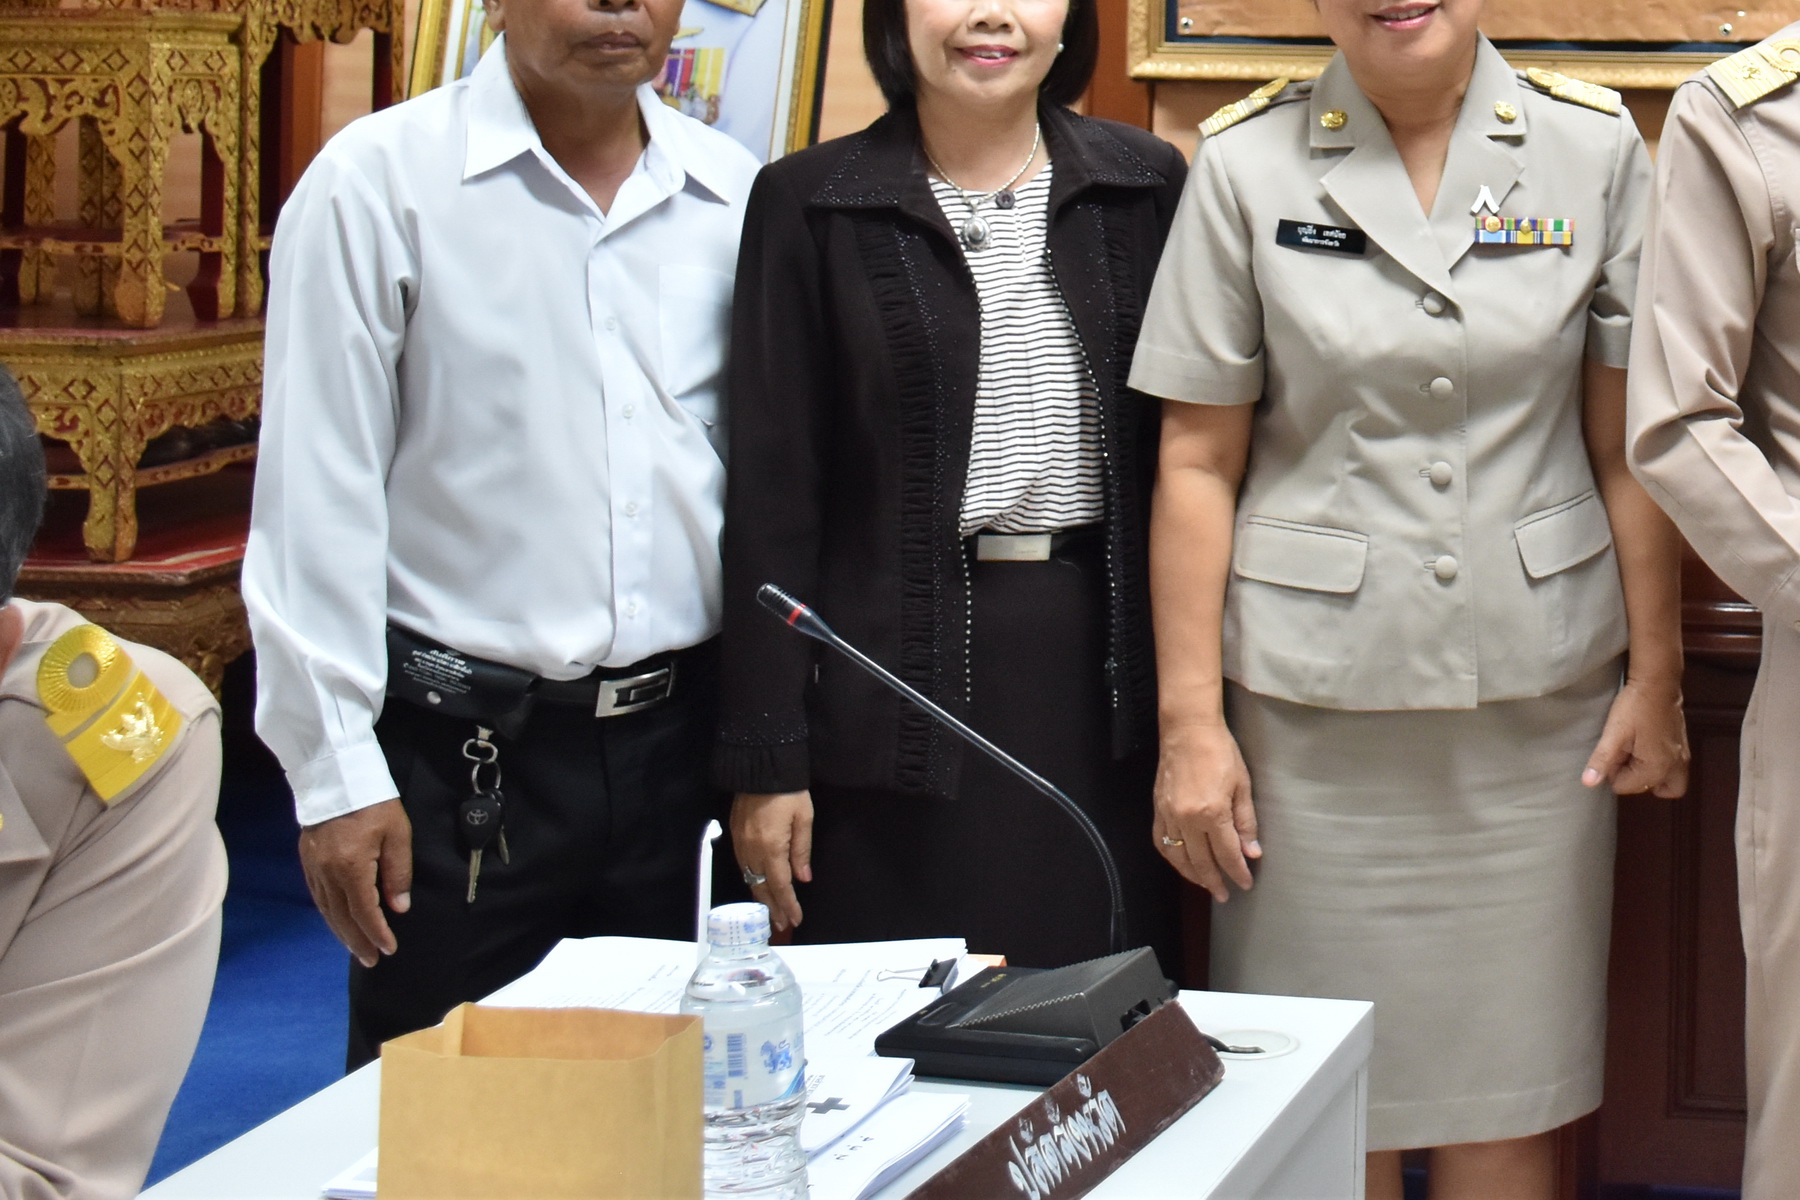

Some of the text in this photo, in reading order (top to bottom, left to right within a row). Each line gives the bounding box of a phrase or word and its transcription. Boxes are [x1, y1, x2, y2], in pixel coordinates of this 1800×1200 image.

[1007, 1072, 1127, 1200] ปลัดจังหวัด
